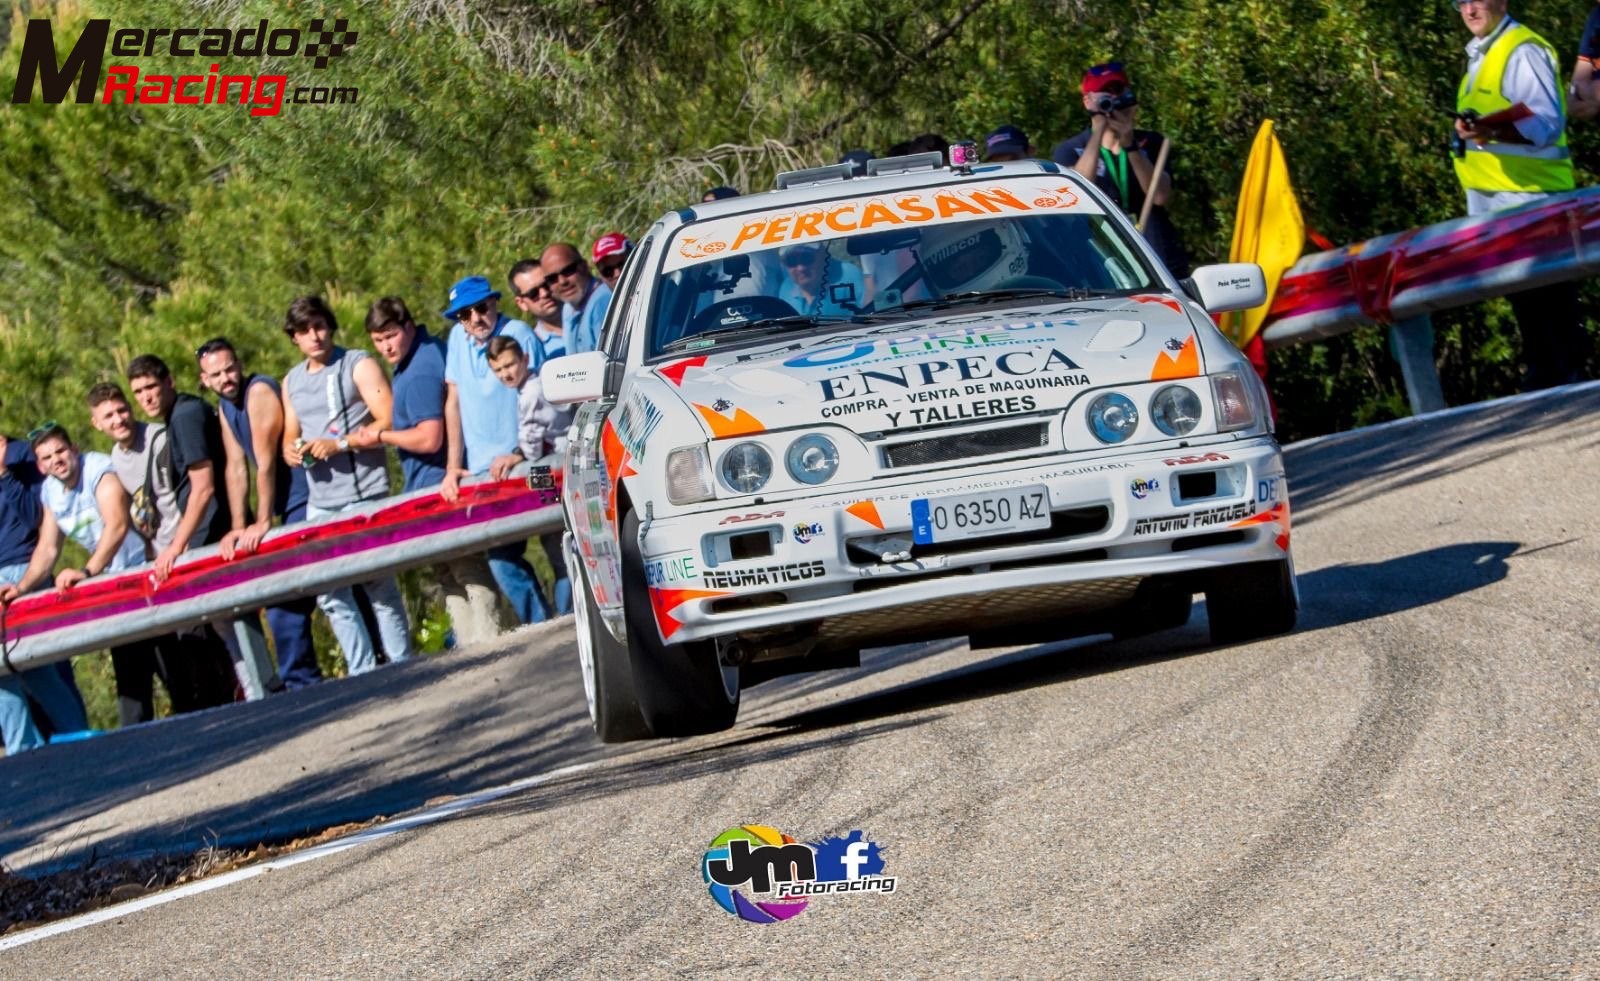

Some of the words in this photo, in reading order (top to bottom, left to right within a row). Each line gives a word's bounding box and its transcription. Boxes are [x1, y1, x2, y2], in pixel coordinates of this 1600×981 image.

[730, 186, 1032, 251] PERCASAN
[890, 332, 1014, 355] LINE
[818, 347, 1085, 403] ENPECA
[821, 397, 889, 419] COMPRA
[906, 387, 960, 404] VENTA
[964, 383, 986, 396] DE
[990, 373, 1091, 393] MAQUINARIA
[885, 411, 902, 428] Y
[910, 394, 1037, 425] TALLERES
[954, 496, 1012, 529] 6350
[1018, 492, 1046, 521] AZ
[1133, 513, 1191, 536] ANTONIO
[918, 525, 928, 536] E
[666, 557, 698, 582] LINE
[702, 560, 826, 589] NEUMATICOS
